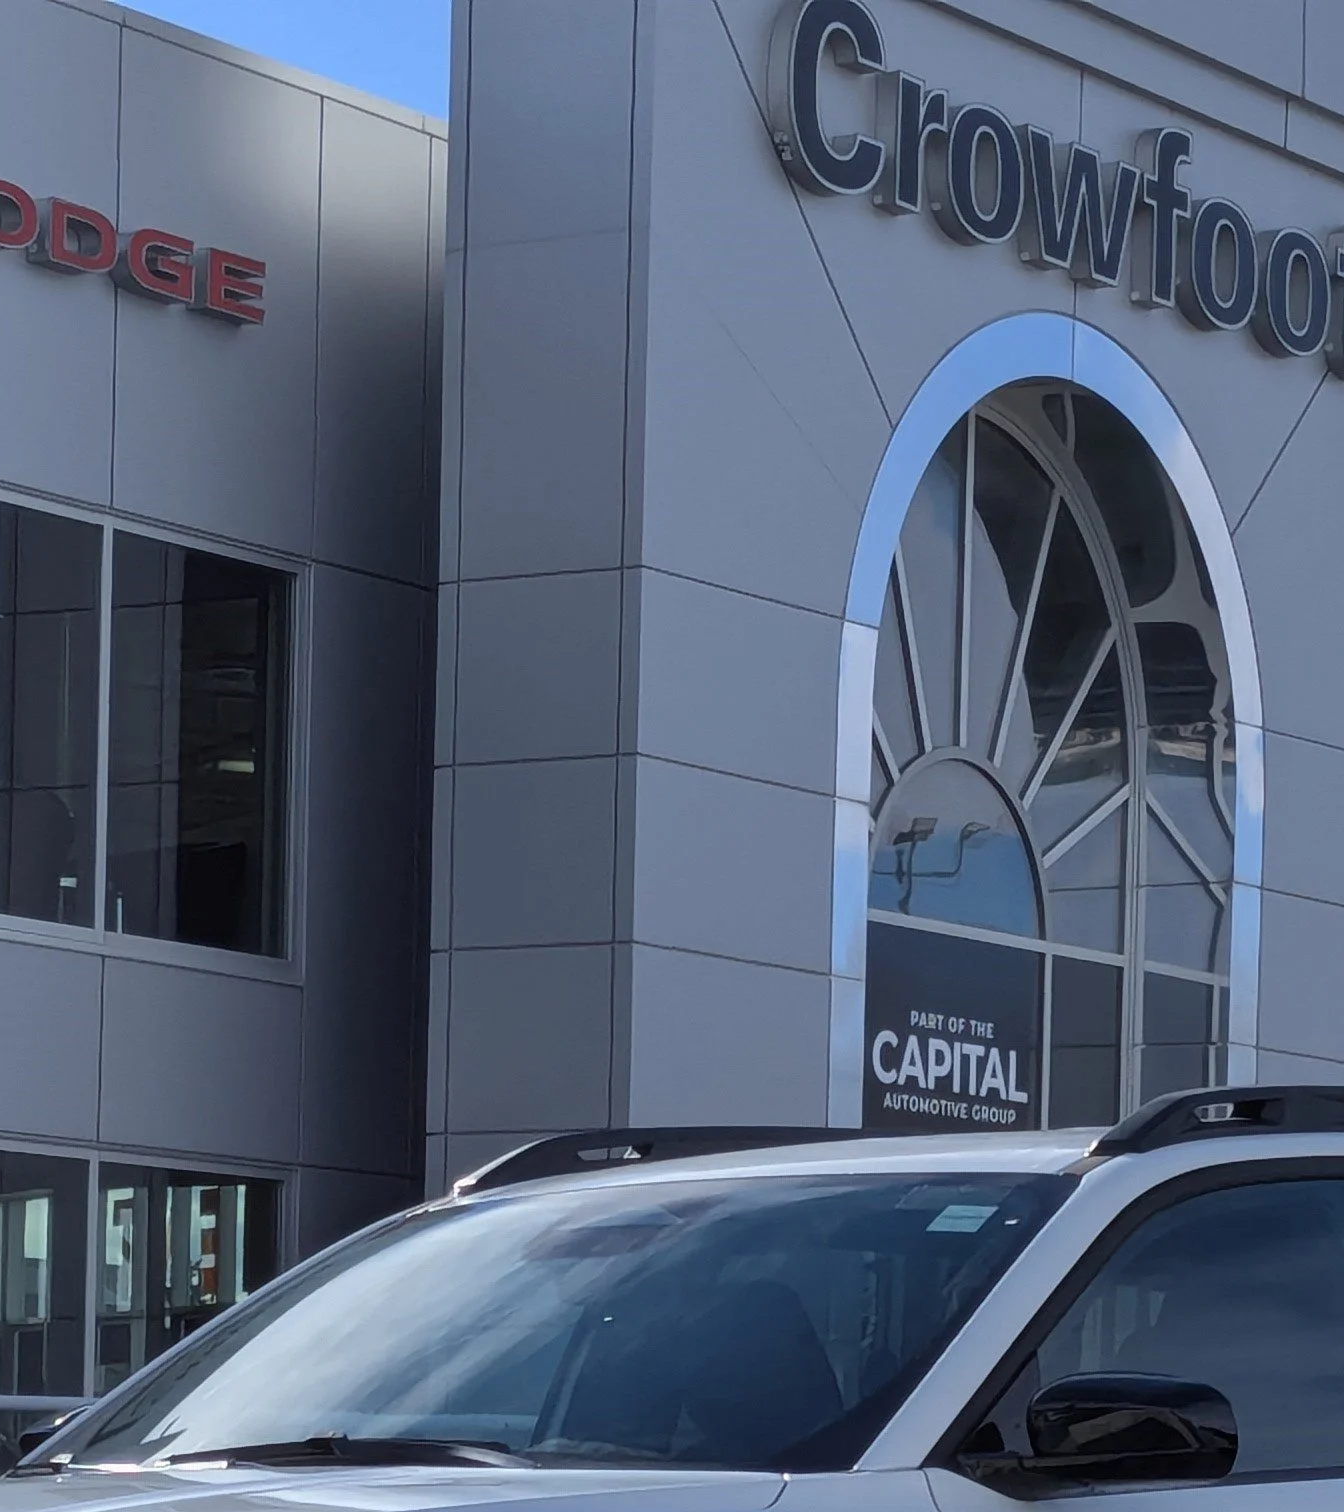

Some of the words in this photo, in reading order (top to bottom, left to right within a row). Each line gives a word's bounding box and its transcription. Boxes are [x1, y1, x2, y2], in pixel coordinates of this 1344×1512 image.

[910, 1009, 945, 1030] PART
[948, 1015, 966, 1034] OF
[969, 1019, 995, 1040] THE
[872, 1029, 1029, 1104] CAPITAL
[883, 1091, 969, 1120] AUTOMOTIVE
[971, 1104, 1017, 1125] GROUP
